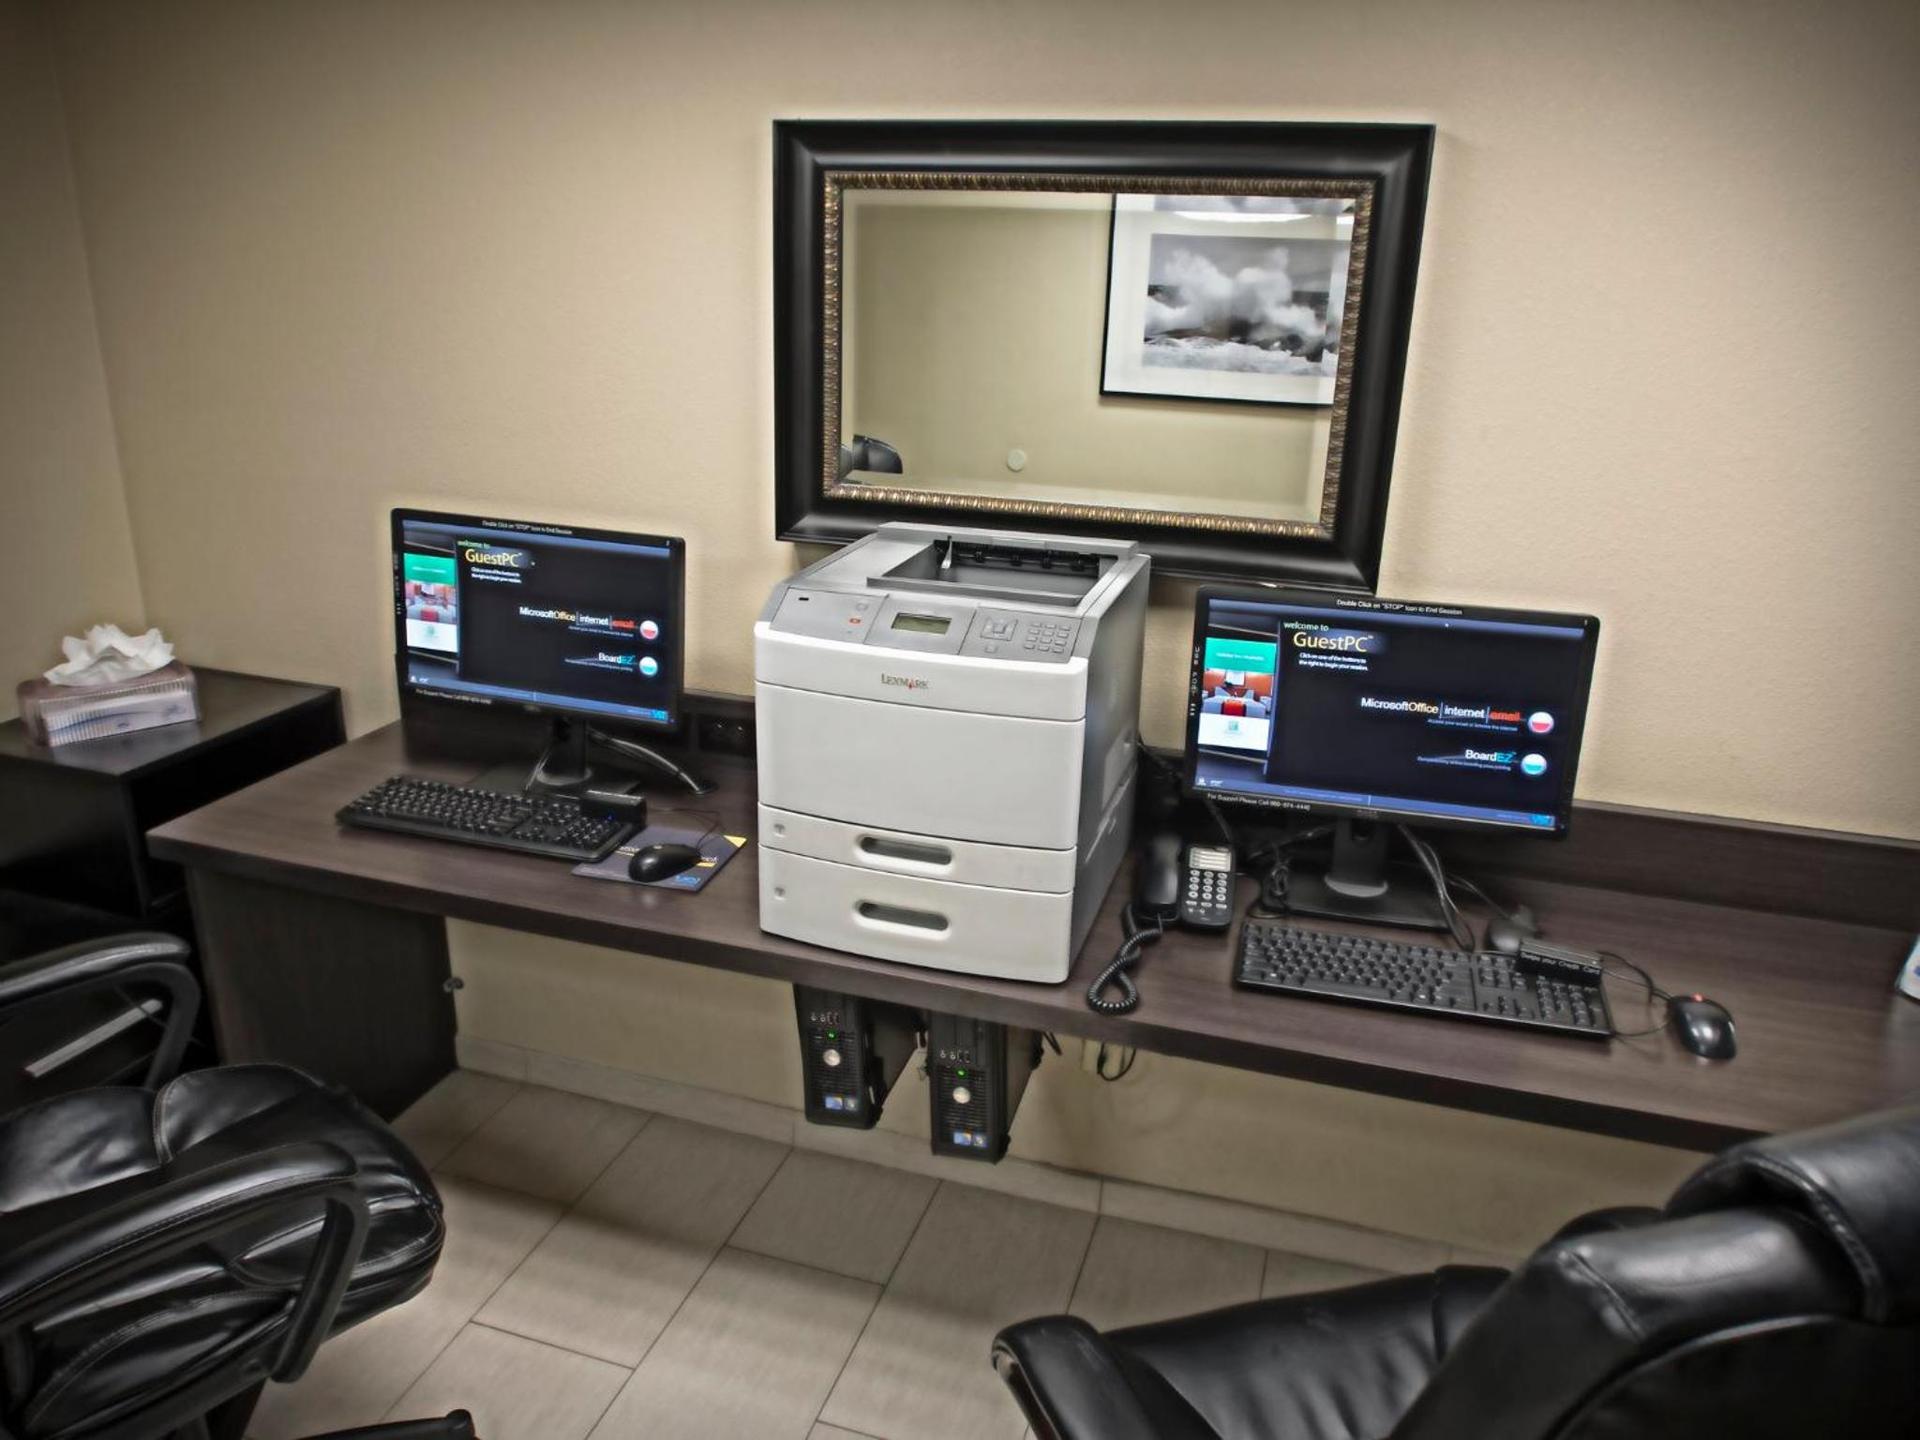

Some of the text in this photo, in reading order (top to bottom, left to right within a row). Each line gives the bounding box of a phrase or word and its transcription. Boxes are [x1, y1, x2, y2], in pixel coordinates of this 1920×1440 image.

[1284, 621, 1329, 632] welcome to
[1444, 705, 1485, 718] internet
